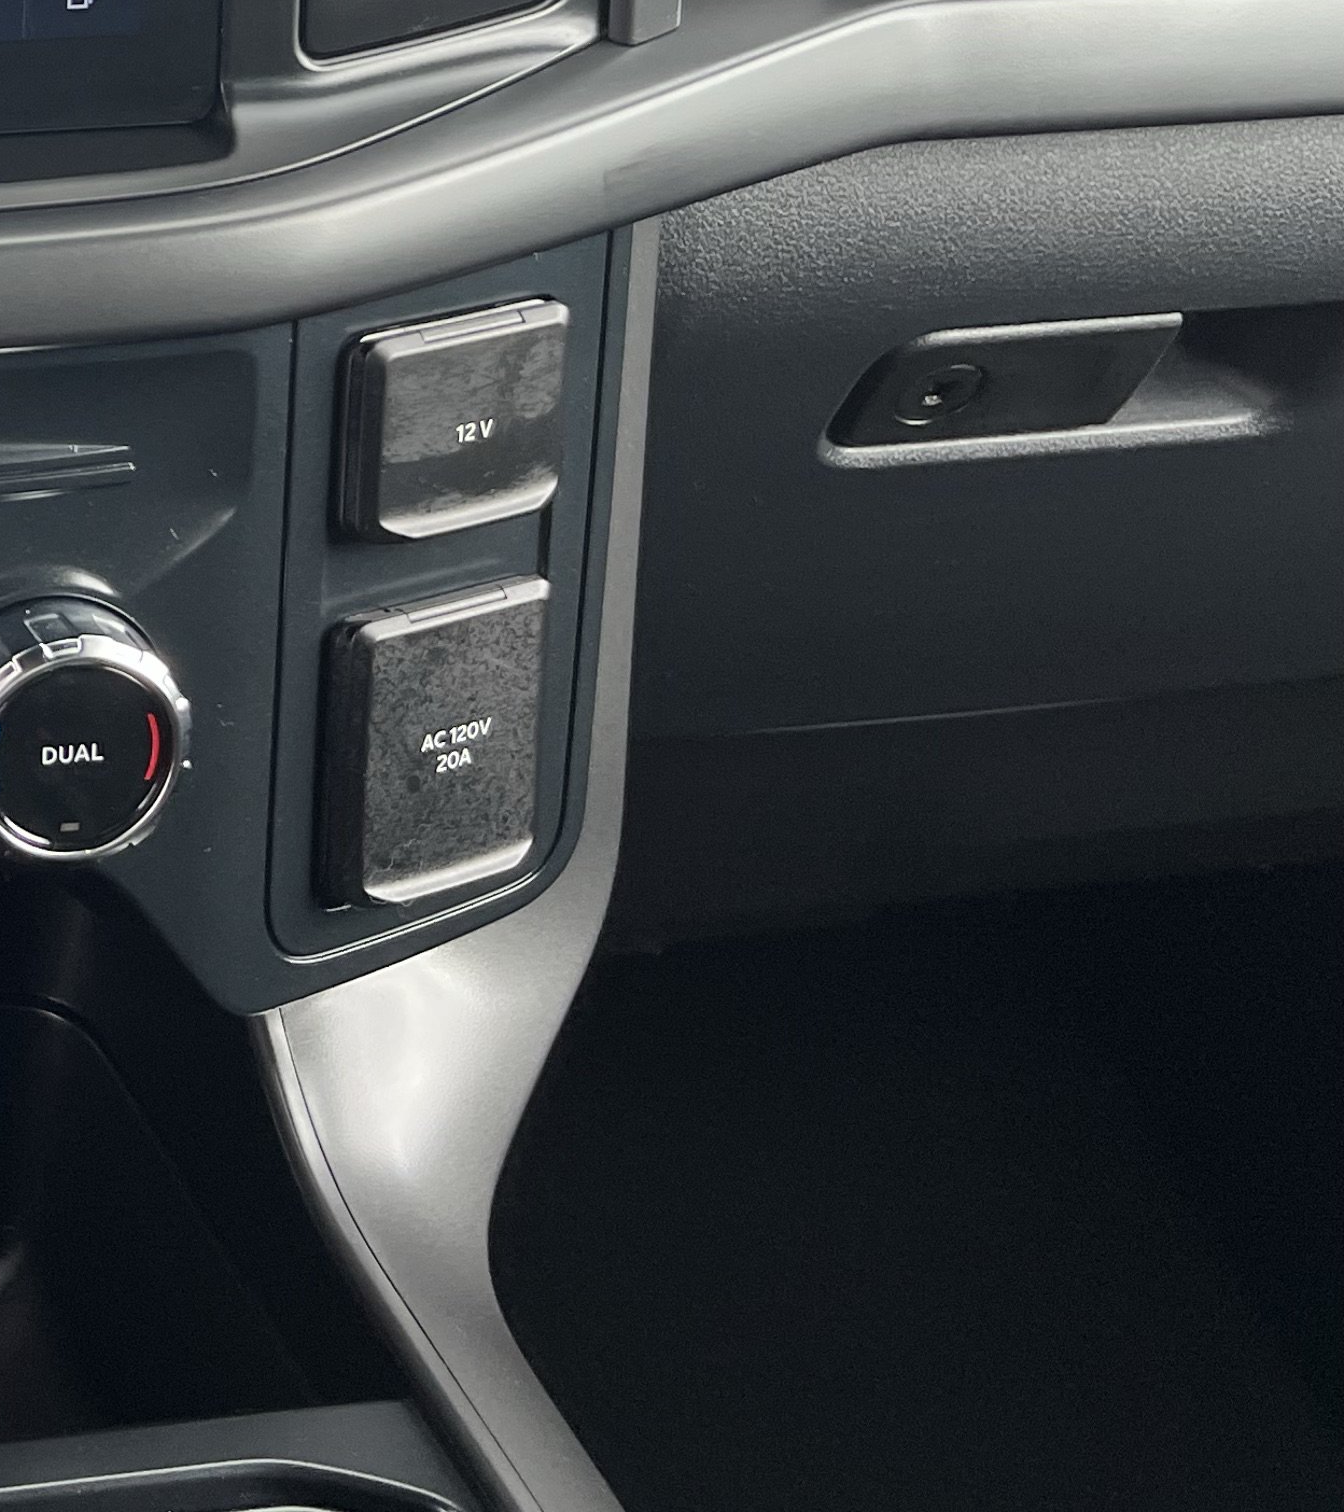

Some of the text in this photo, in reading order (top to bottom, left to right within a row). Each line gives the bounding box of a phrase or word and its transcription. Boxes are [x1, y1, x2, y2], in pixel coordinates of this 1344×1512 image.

[420, 716, 494, 754] AC 120V
[41, 742, 105, 766] DUAL
[435, 748, 473, 775] 20A
